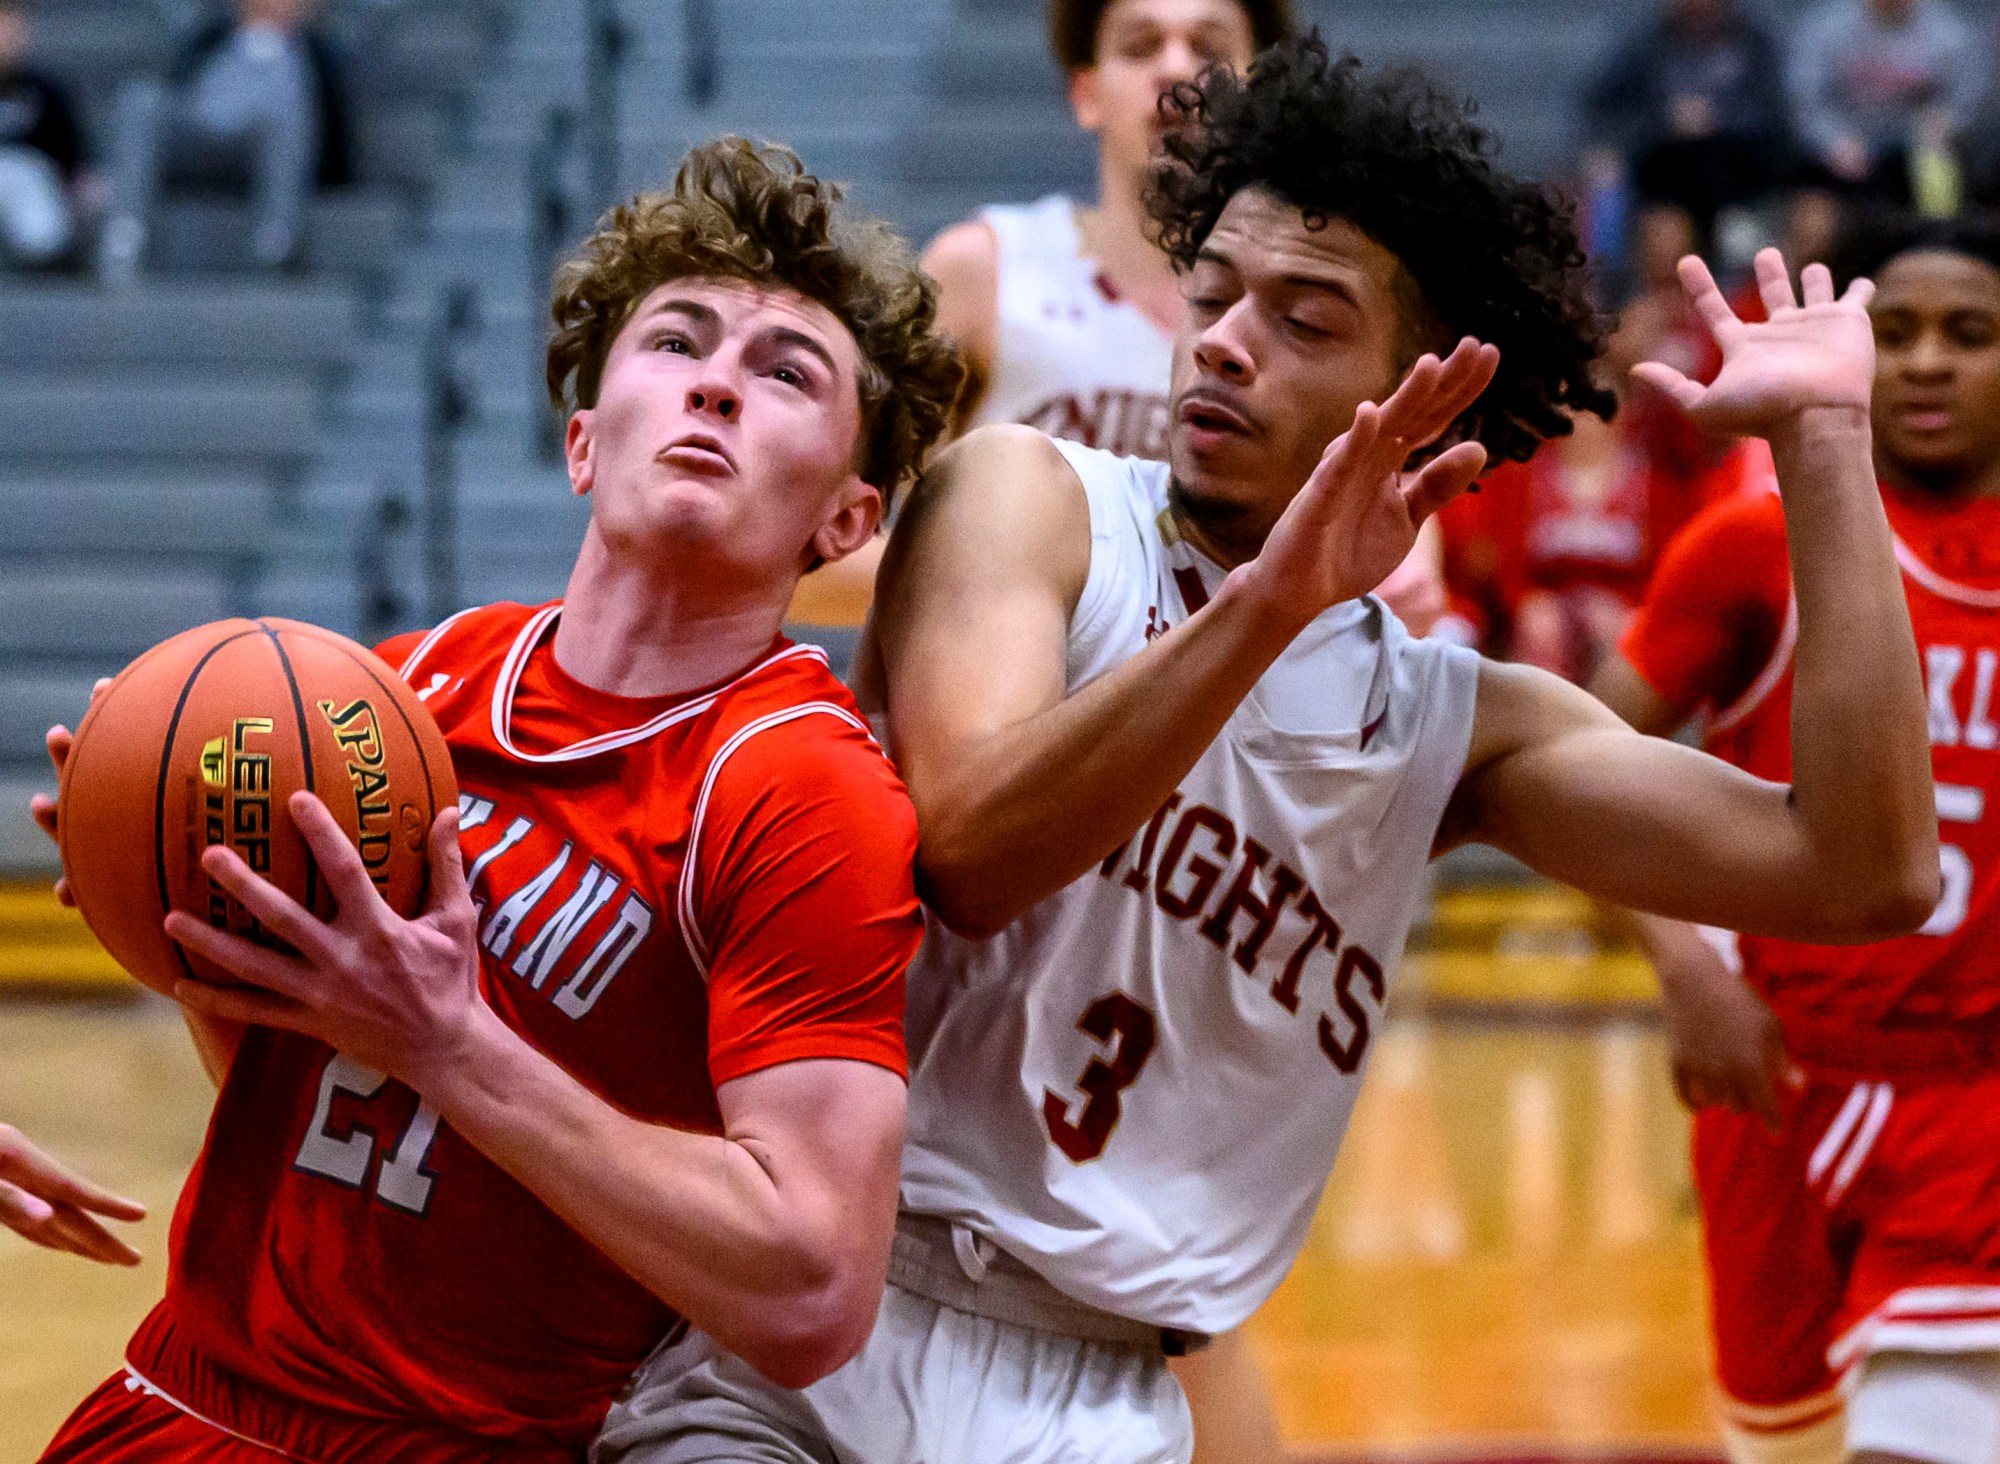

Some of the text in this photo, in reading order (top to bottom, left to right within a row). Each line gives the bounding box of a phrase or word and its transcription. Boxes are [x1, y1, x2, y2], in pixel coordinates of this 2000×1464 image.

[317, 699, 392, 902] SPALDI
[1101, 791, 1386, 1075] IGHTS
[292, 1052, 439, 1218] 21
[1043, 988, 1157, 1166] 3
